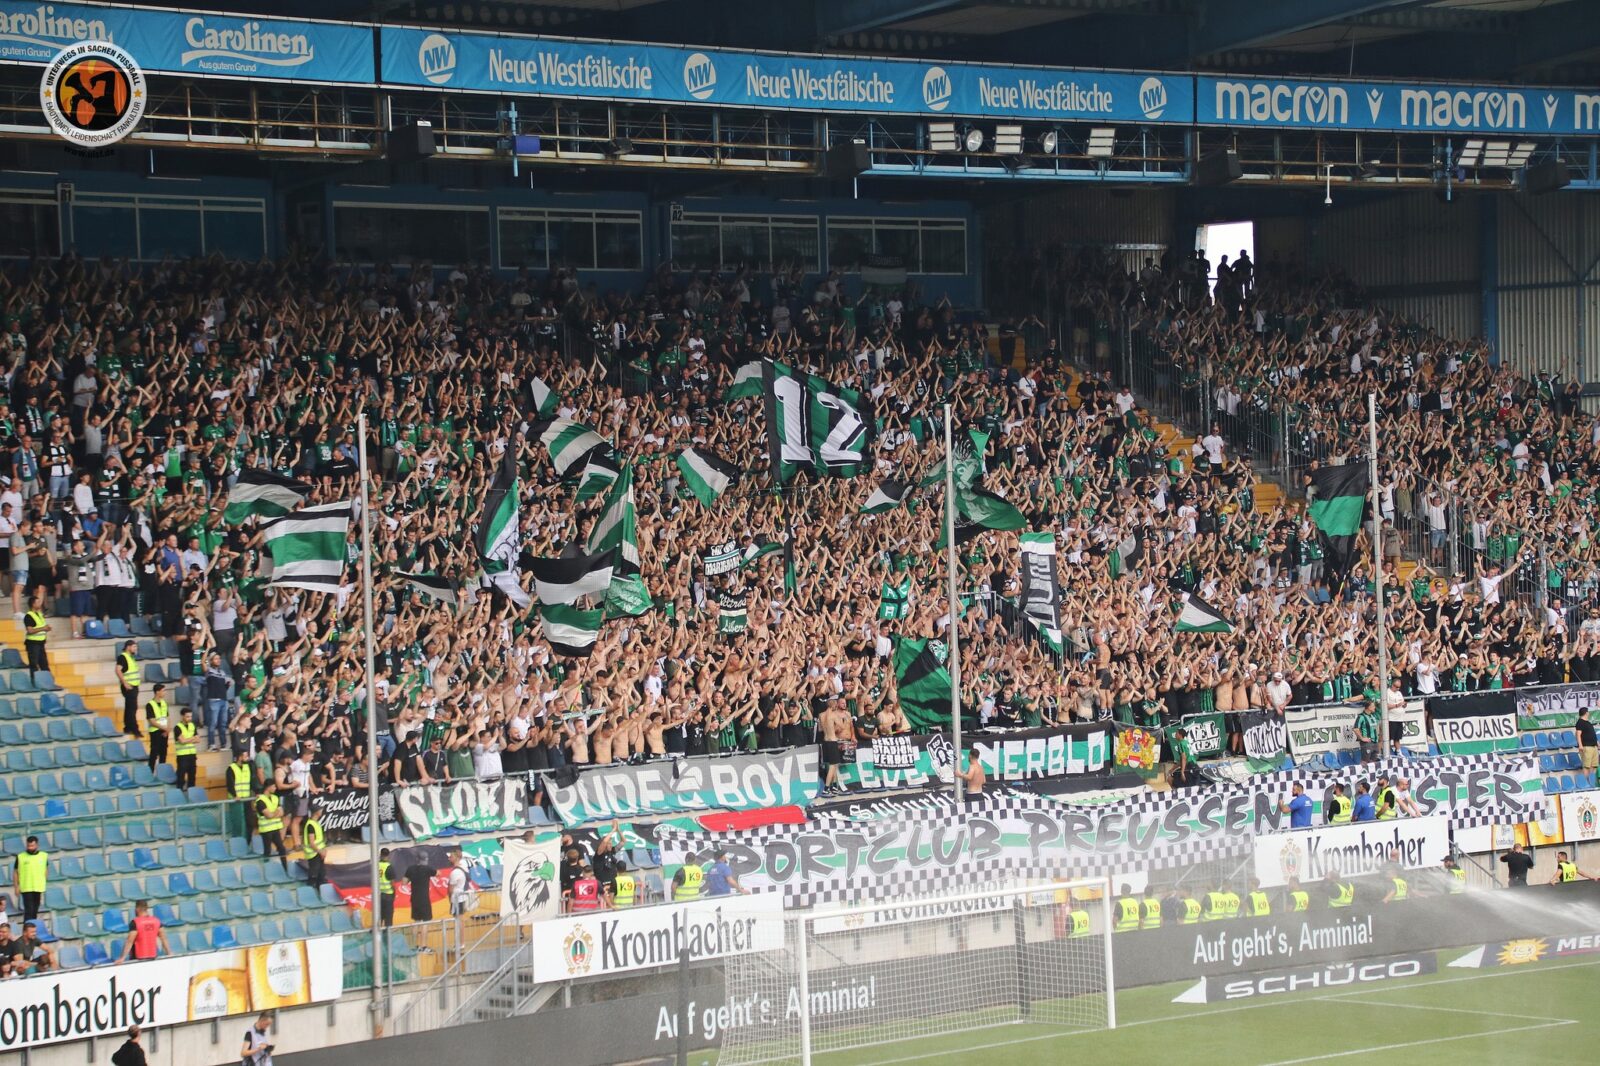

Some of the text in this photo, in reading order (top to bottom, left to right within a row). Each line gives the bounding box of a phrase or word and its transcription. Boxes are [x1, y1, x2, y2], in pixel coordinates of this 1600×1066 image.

[185, 17, 310, 56] Carolinen
[235, 63, 257, 72] Grund
[489, 49, 537, 84] Neue
[538, 52, 652, 90] Westfälische
[746, 65, 790, 99] Neue
[792, 68, 894, 103] Westfälische
[979, 77, 1018, 108] Neue
[1018, 78, 1113, 112] Westfälische
[1215, 82, 1348, 124] macron
[1401, 89, 1526, 129] macron
[774, 375, 867, 467] 12
[1291, 726, 1341, 747] WEST
[1438, 717, 1515, 741] TROJANS
[873, 744, 913, 755] STADION
[874, 754, 914, 765] VERBOT
[548, 768, 663, 828] RUDE
[1020, 782, 1284, 859] PREUSSEN
[1306, 827, 1426, 880] Krombacher
[619, 882, 633, 892] K9
[688, 871, 701, 882] K9
[1127, 905, 1138, 916] K9
[1149, 903, 1160, 913] K9
[1189, 905, 1200, 915] K9
[600, 905, 756, 971] Krombacher
[1193, 914, 1374, 967] Auf geht's, Arminia!
[1225, 959, 1421, 1000] SCHÜCO
[0, 975, 162, 1046] ombacher
[702, 992, 777, 1041] geht's,
[785, 975, 876, 1020] Aminia!
